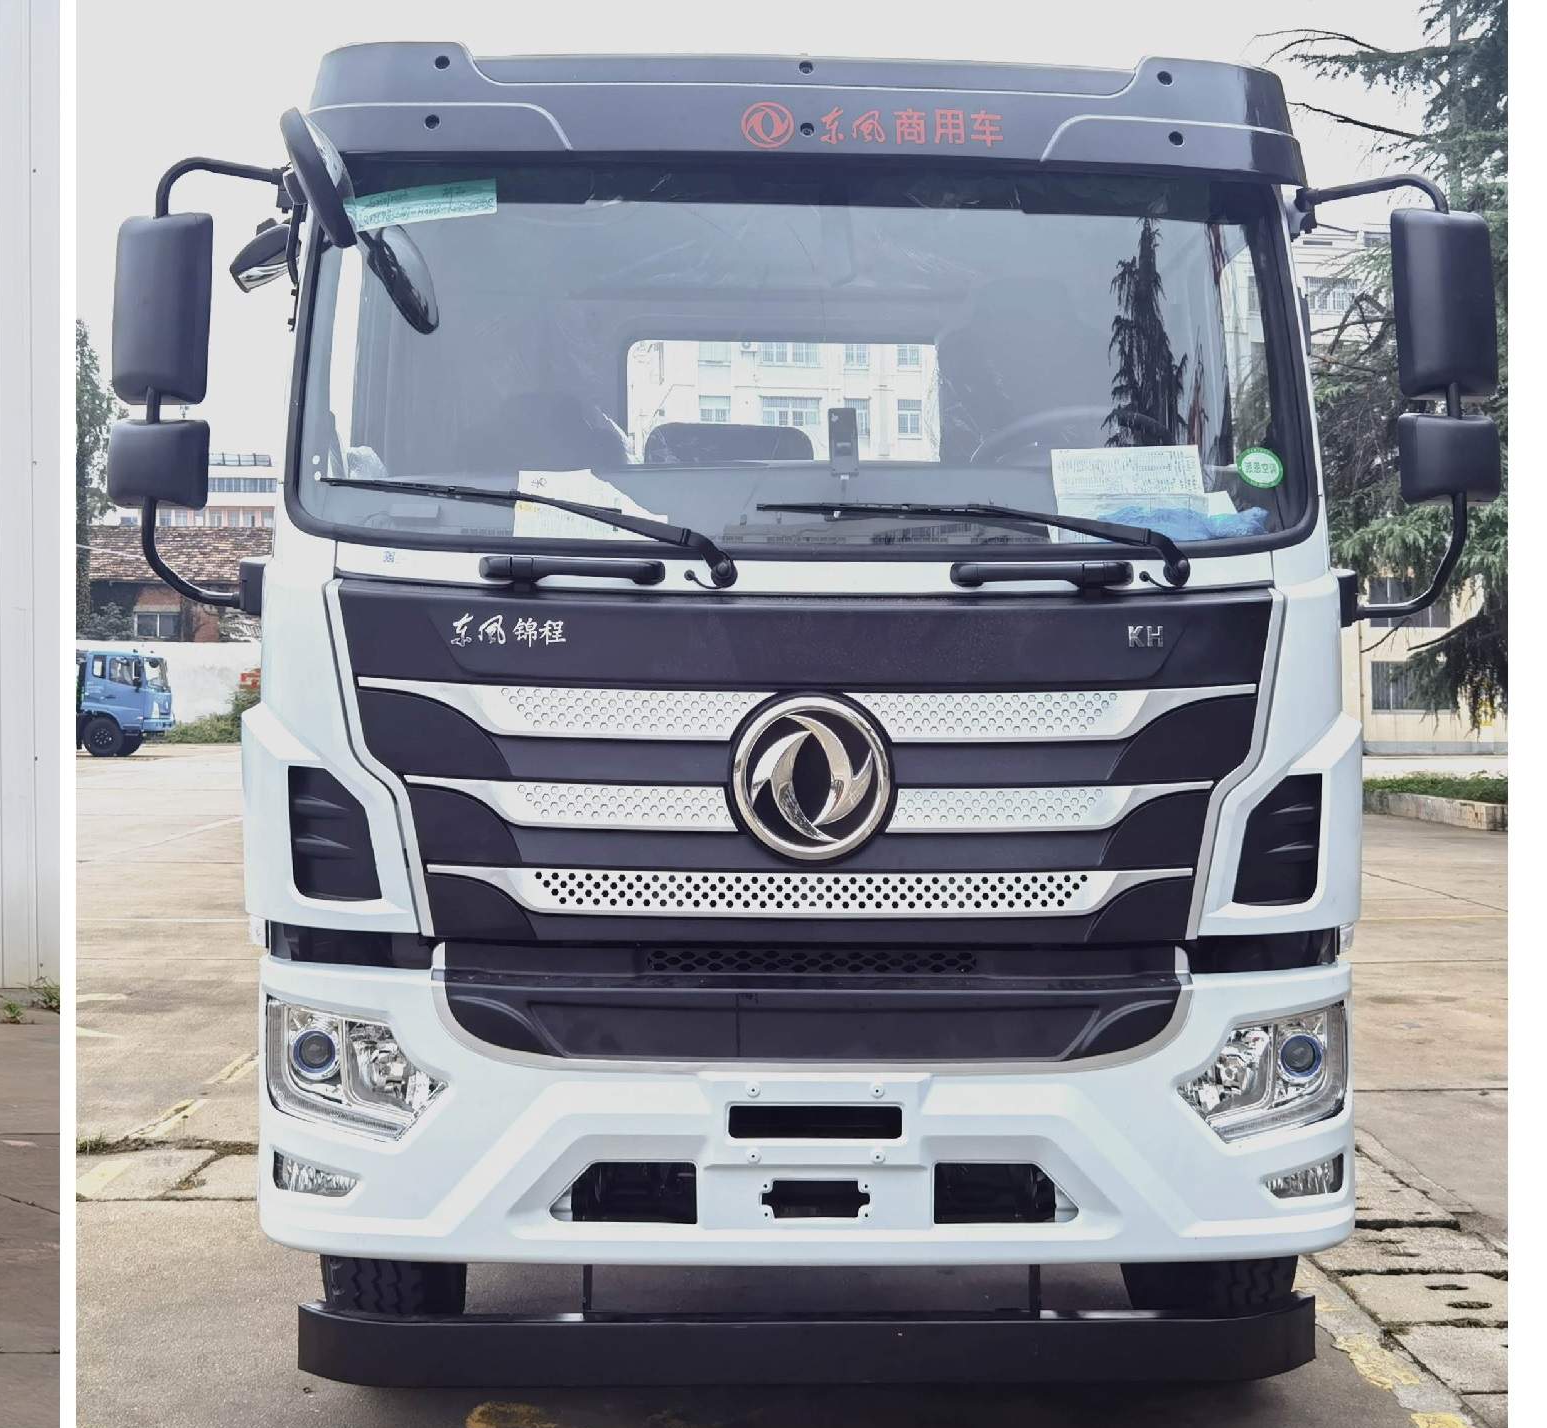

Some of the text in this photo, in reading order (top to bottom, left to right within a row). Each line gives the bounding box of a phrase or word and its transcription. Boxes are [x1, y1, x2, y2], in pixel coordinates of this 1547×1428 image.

[819, 105, 1005, 148] 东风商用车
[450, 612, 567, 648] 东风锦程
[1127, 625, 1164, 648] KH
